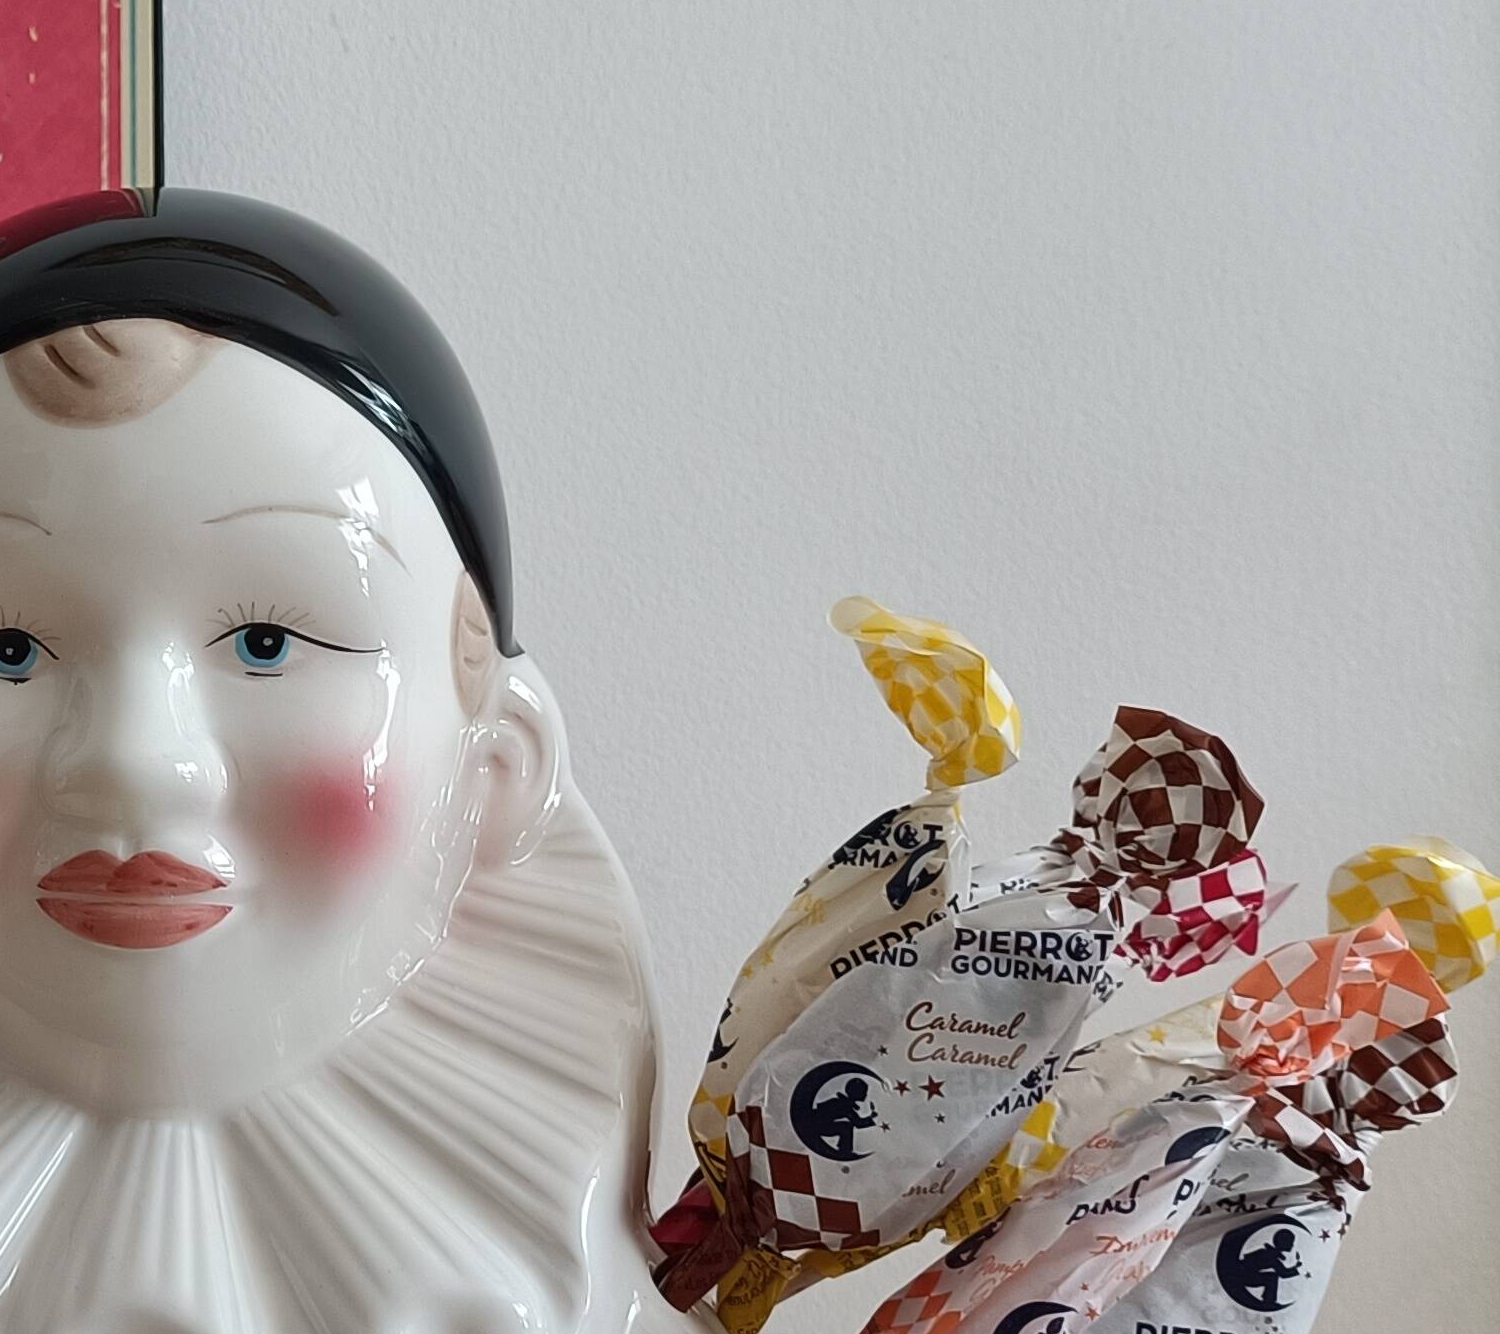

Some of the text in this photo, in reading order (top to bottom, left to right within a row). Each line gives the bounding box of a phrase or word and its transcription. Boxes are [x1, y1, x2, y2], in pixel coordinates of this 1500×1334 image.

[954, 928, 1114, 962] PIERROT
[905, 1001, 1026, 1040] Caramel
[907, 1032, 1028, 1070] Caramel
